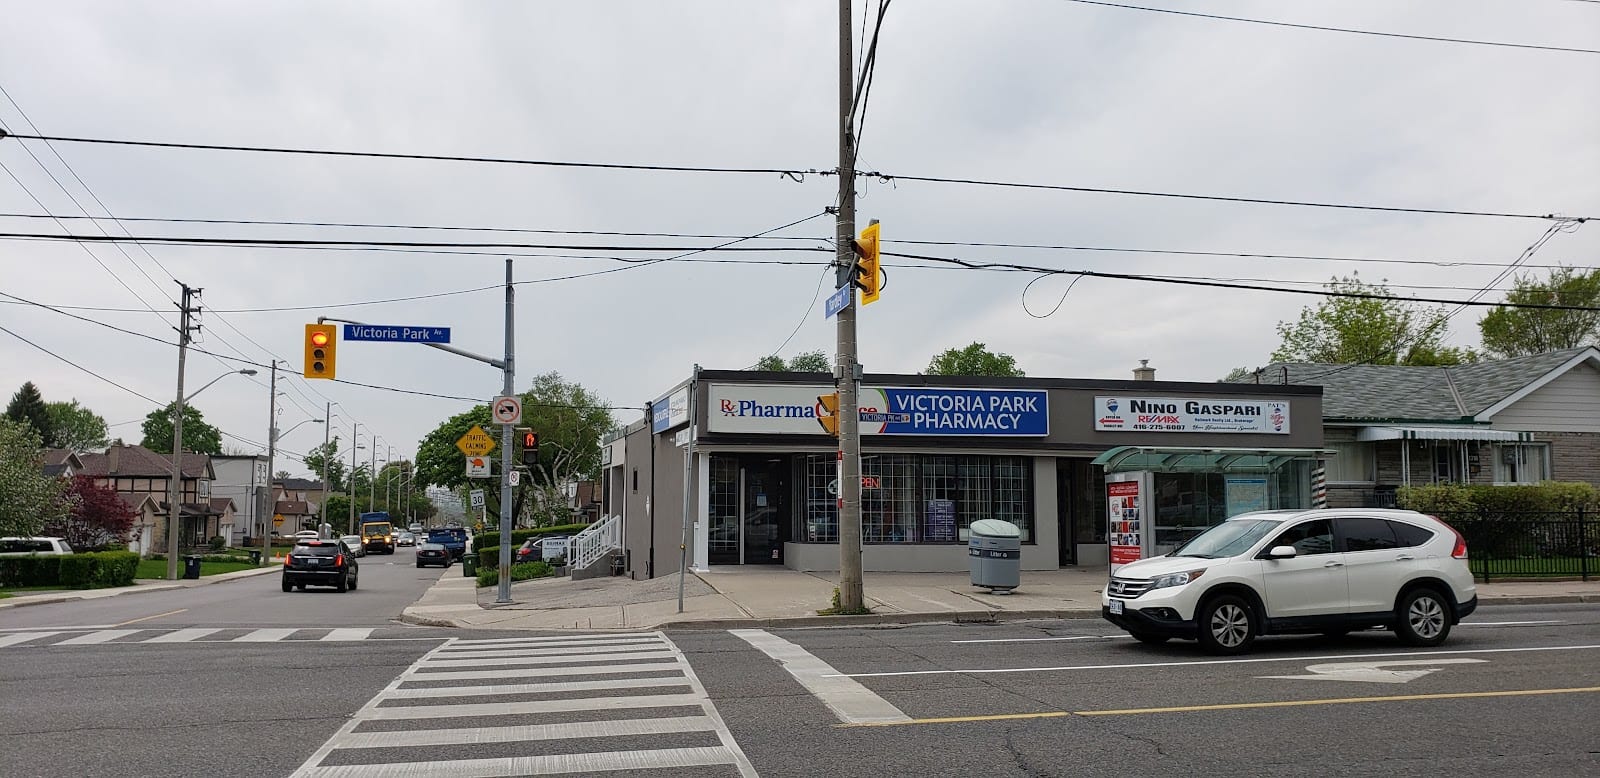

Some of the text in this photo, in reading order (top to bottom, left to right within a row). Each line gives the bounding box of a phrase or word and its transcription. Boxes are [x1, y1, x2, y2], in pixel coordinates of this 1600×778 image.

[352, 326, 398, 339] Victoria
[403, 328, 430, 340] Park
[738, 400, 879, 418] PharmaCre
[896, 394, 1038, 412] VICTORIA PARK
[861, 413, 887, 422] VICTORIA
[914, 412, 1021, 429] PHARMACY
[861, 477, 879, 489] PEN
[472, 496, 483, 504] 30
